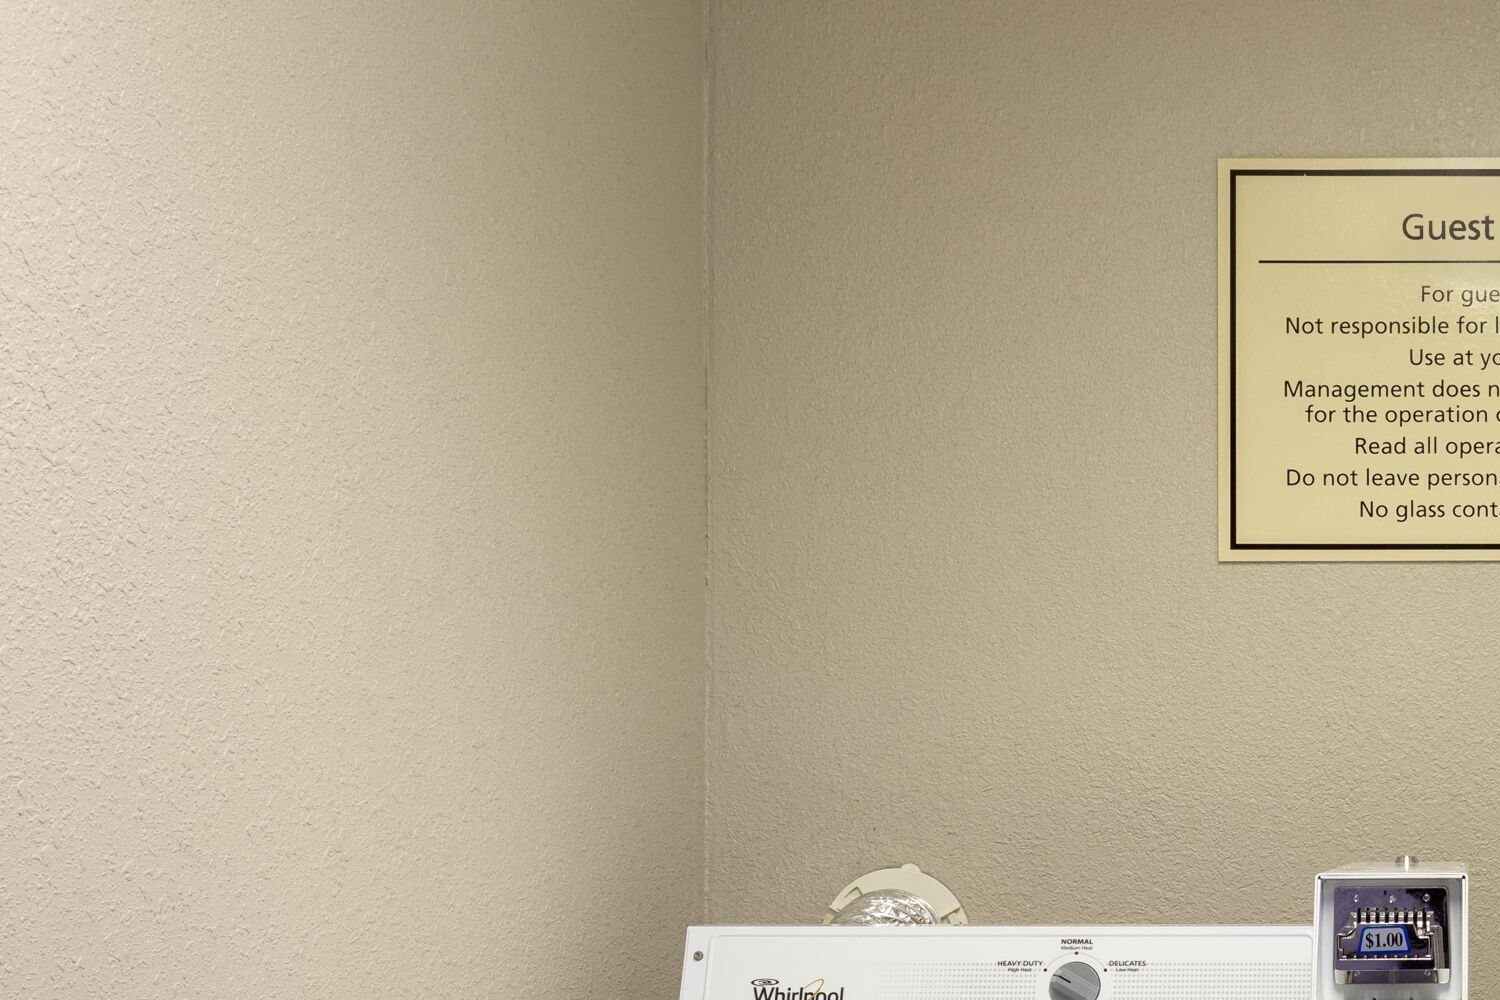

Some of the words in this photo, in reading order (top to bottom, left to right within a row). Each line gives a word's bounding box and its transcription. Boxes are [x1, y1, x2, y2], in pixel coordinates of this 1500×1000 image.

[1401, 212, 1495, 241] Guest
[1421, 285, 1455, 303] For
[1285, 316, 1324, 335] Not
[1330, 315, 1450, 340] responsible
[1455, 315, 1489, 335] for
[1409, 348, 1446, 367] Use
[1452, 349, 1474, 367] at
[1283, 379, 1426, 403] Management
[1431, 378, 1481, 398] does
[1304, 403, 1337, 424] for
[1342, 403, 1378, 424] the
[1384, 404, 1488, 428] operation
[1355, 435, 1407, 455] Read
[1413, 435, 1438, 455] all
[1286, 468, 1316, 487] Do
[1322, 469, 1359, 487] not
[1365, 467, 1420, 487] leave
[1359, 500, 1389, 519] No
[1395, 499, 1446, 523] glass
[1364, 932, 1404, 949] $1.00
